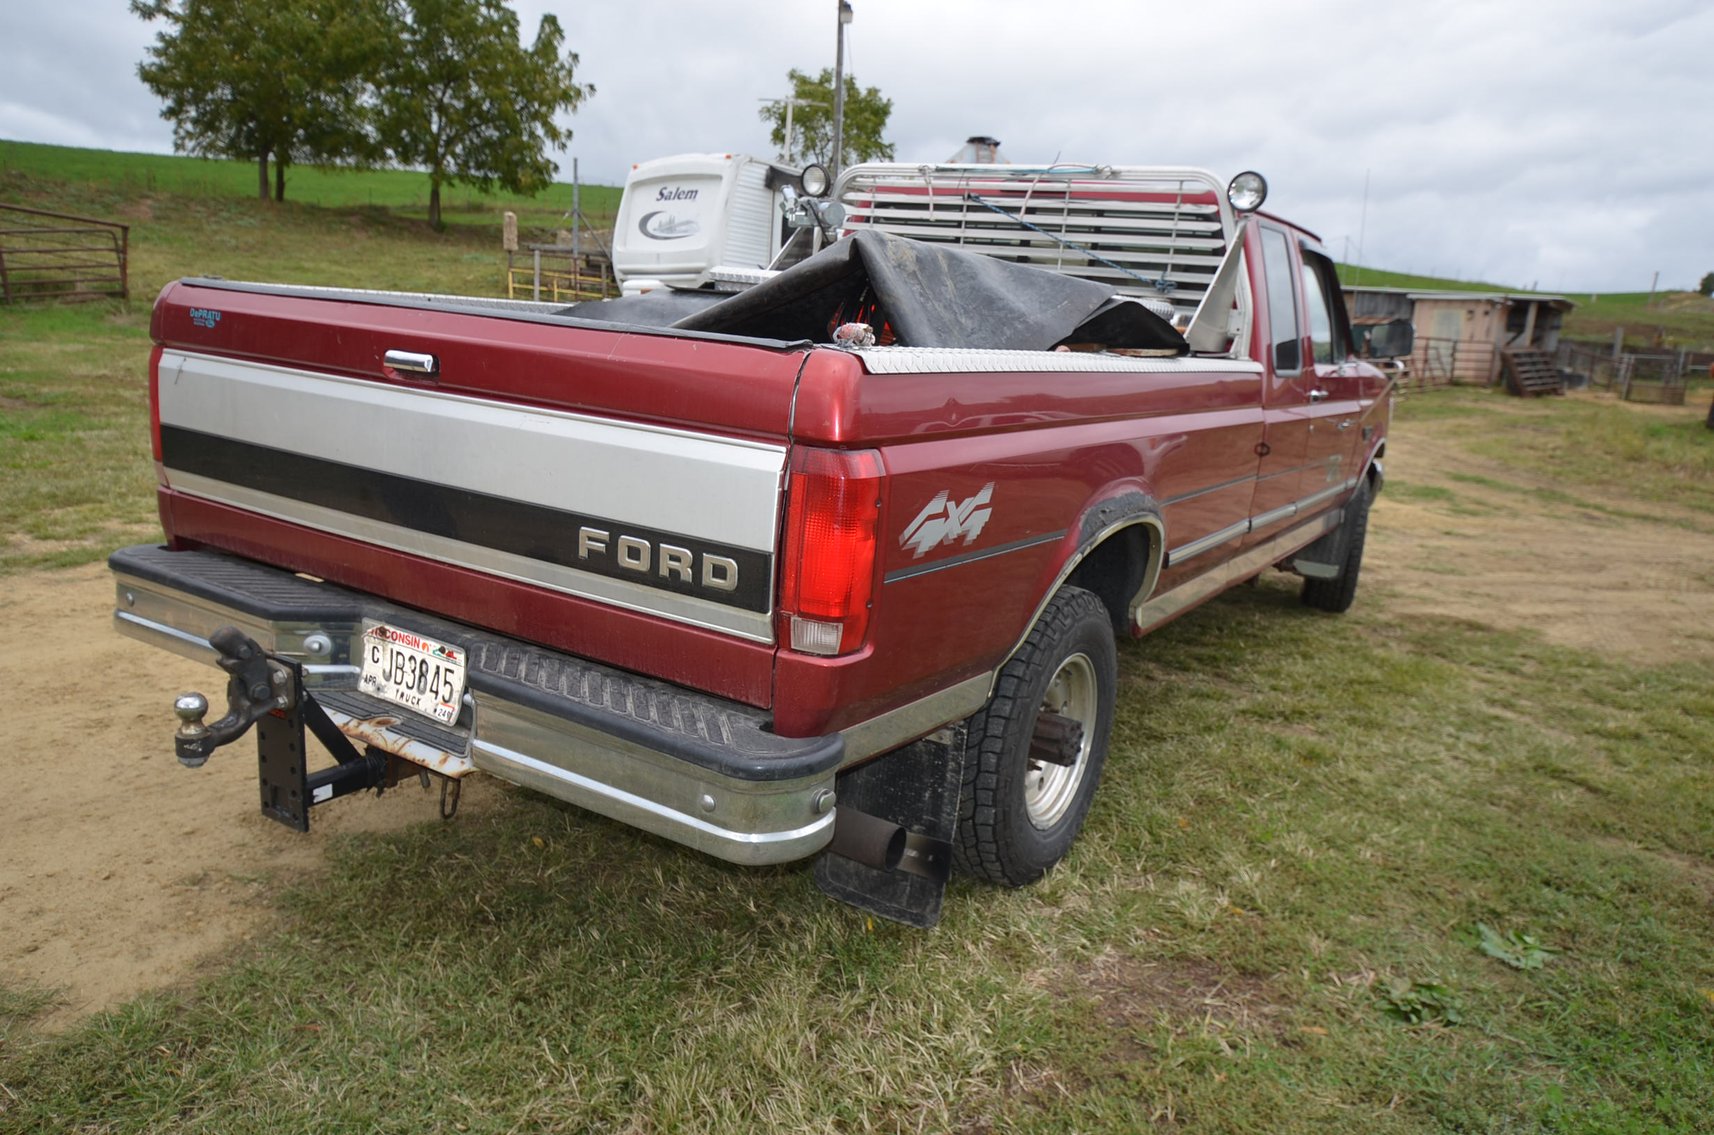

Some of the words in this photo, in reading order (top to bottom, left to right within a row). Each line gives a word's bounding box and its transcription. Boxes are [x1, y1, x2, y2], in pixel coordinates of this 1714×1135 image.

[656, 186, 699, 202] Salem
[578, 526, 738, 592] FORD
[363, 674, 377, 687] APR
[382, 647, 455, 704] JB3845
[395, 689, 422, 706] TRUCK
